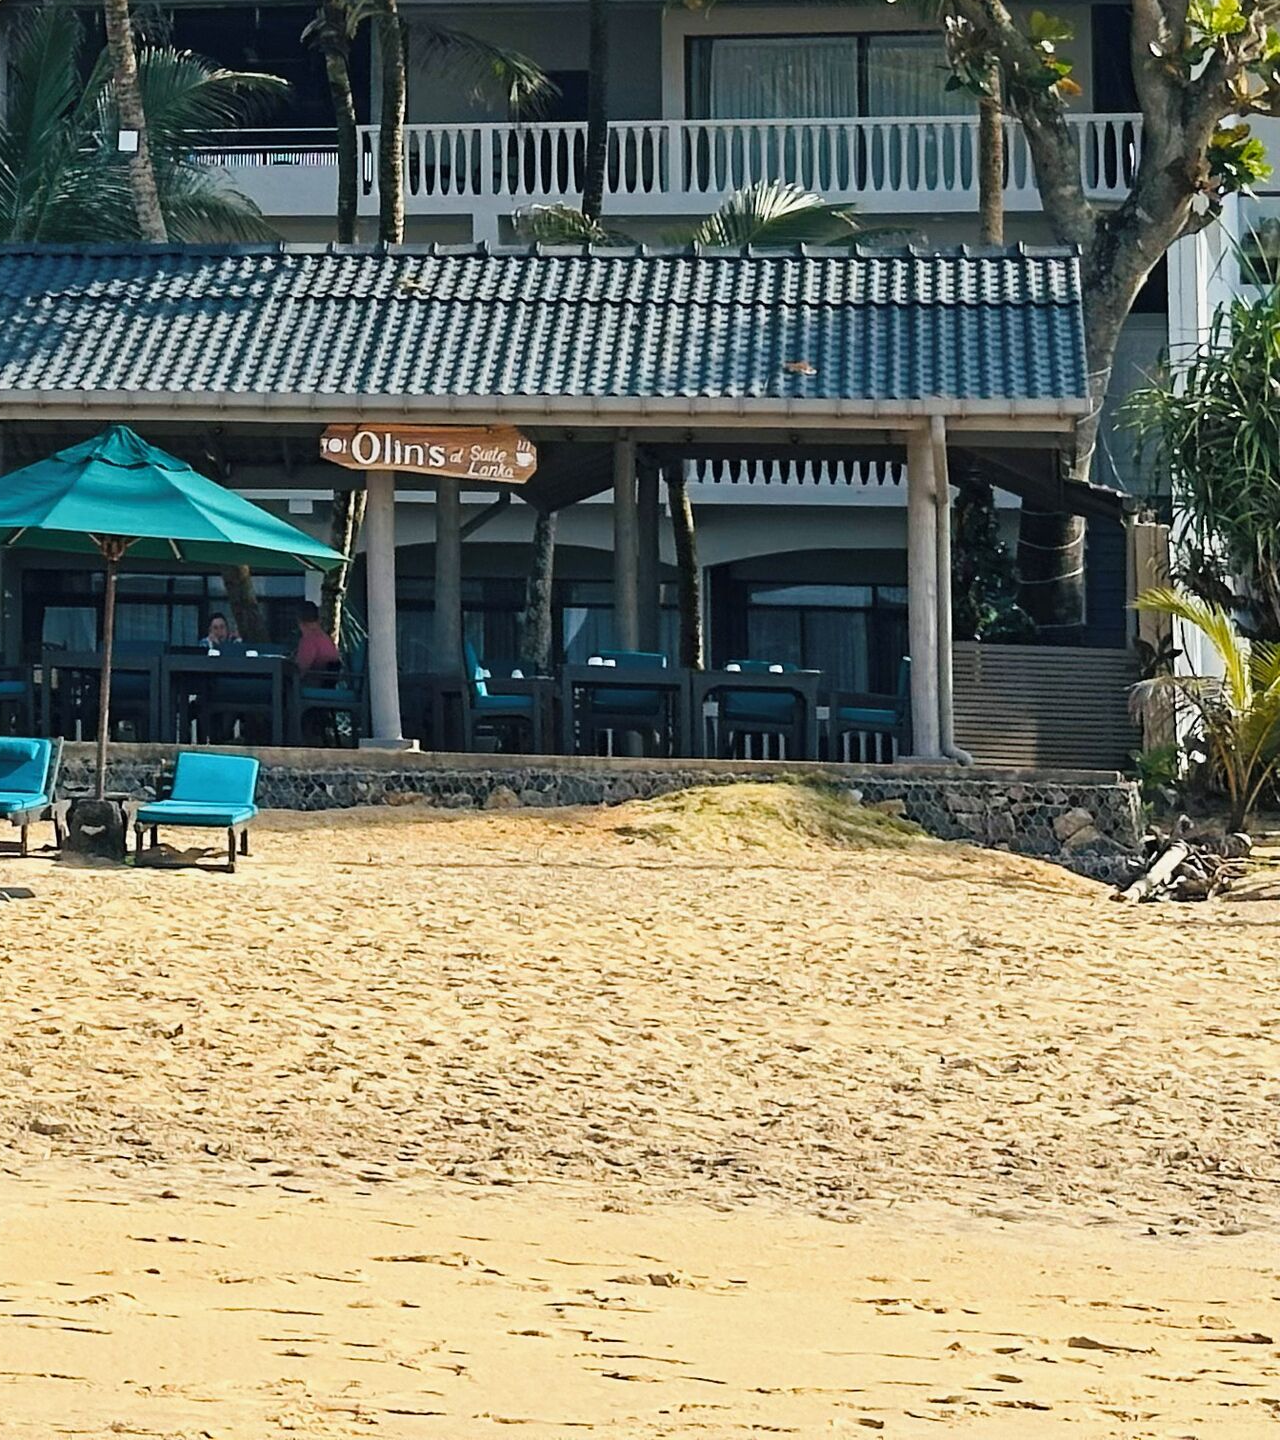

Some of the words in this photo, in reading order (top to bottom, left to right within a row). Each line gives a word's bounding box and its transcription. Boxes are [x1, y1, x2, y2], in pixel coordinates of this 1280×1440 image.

[351, 431, 446, 467] Olin's
[450, 448, 464, 463] at
[469, 444, 508, 462] Suite
[467, 461, 514, 478] Lanka
